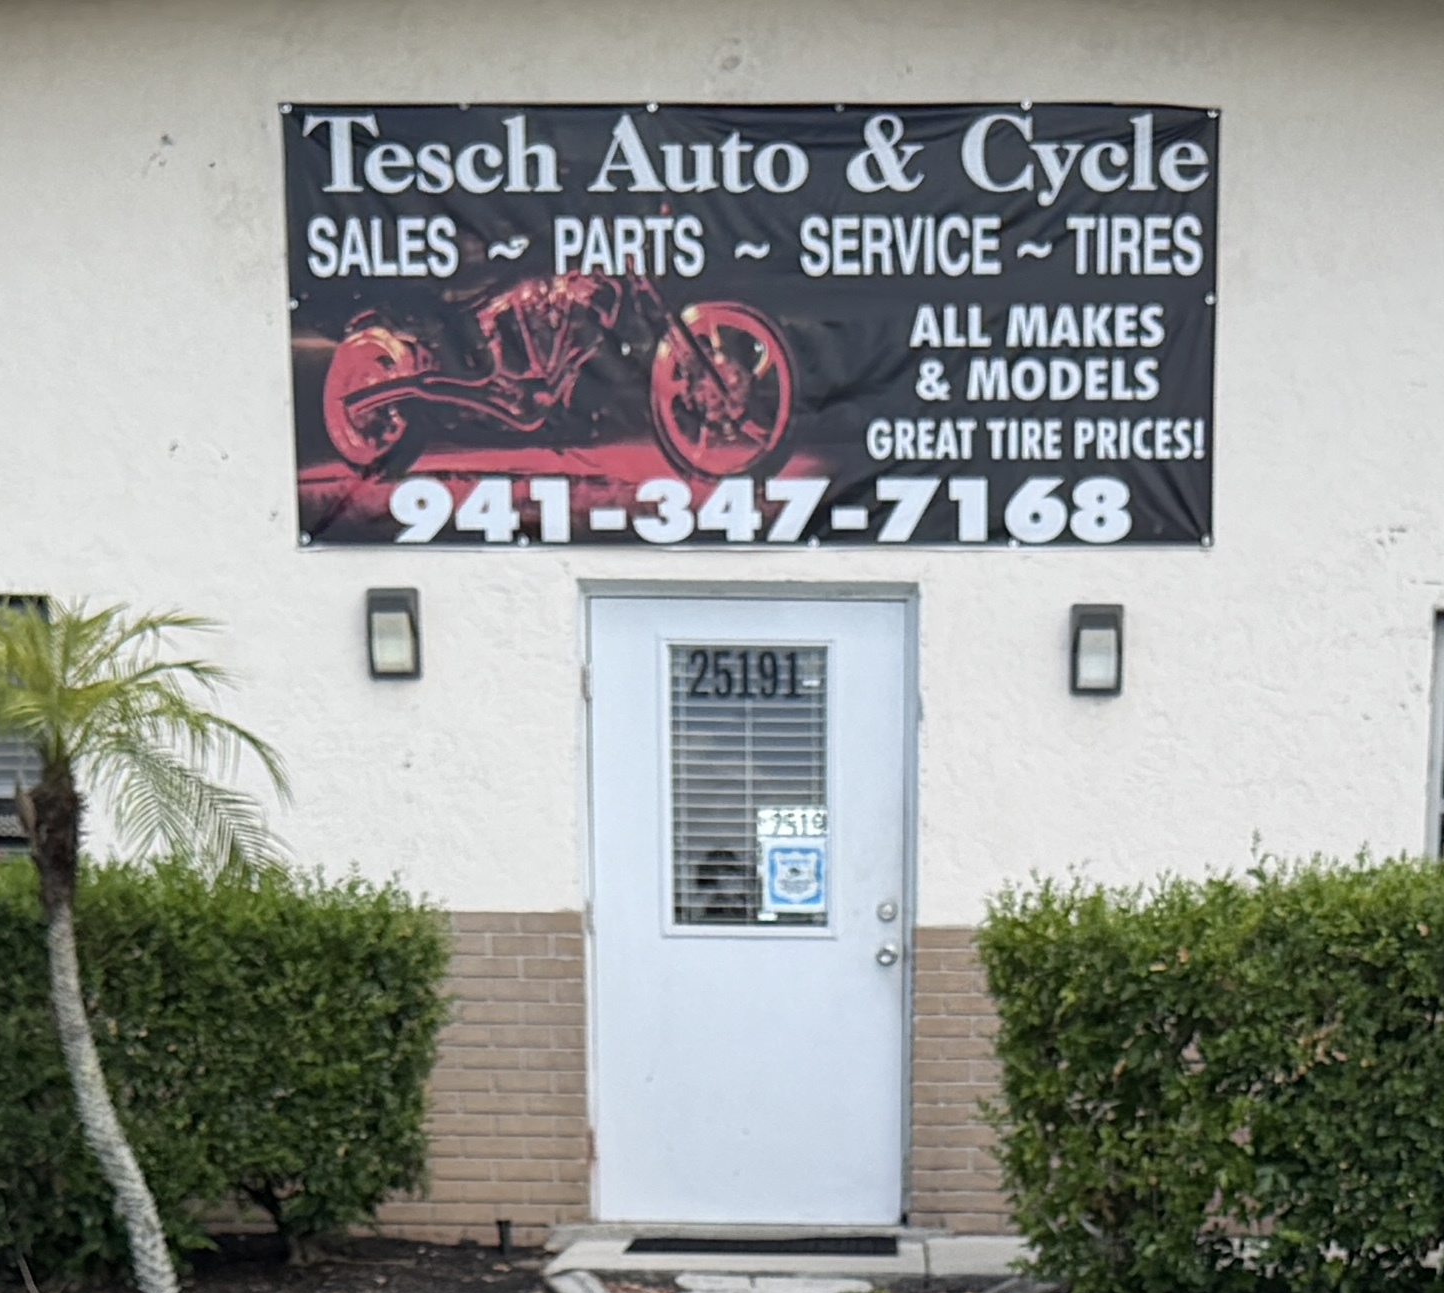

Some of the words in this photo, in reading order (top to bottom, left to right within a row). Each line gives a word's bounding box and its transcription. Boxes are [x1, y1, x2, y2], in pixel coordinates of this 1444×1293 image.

[301, 113, 561, 195] Tesch
[592, 119, 809, 195] Auto
[847, 115, 925, 193] &
[961, 113, 1211, 207] Cycle
[306, 217, 459, 278] SALES
[557, 217, 706, 276] PARTS
[799, 215, 1001, 276] SERVICE
[1067, 216, 1204, 276] TIRES
[909, 305, 992, 349] ALL
[1006, 305, 1166, 349] MAKES
[915, 361, 952, 402] &
[967, 360, 1160, 402] MODELS
[865, 418, 976, 462] GREAT
[984, 418, 1063, 462] TIRE
[1073, 418, 1207, 462] PRICES!
[388, 477, 1133, 544] 941-347-7168
[689, 650, 804, 699] 25191
